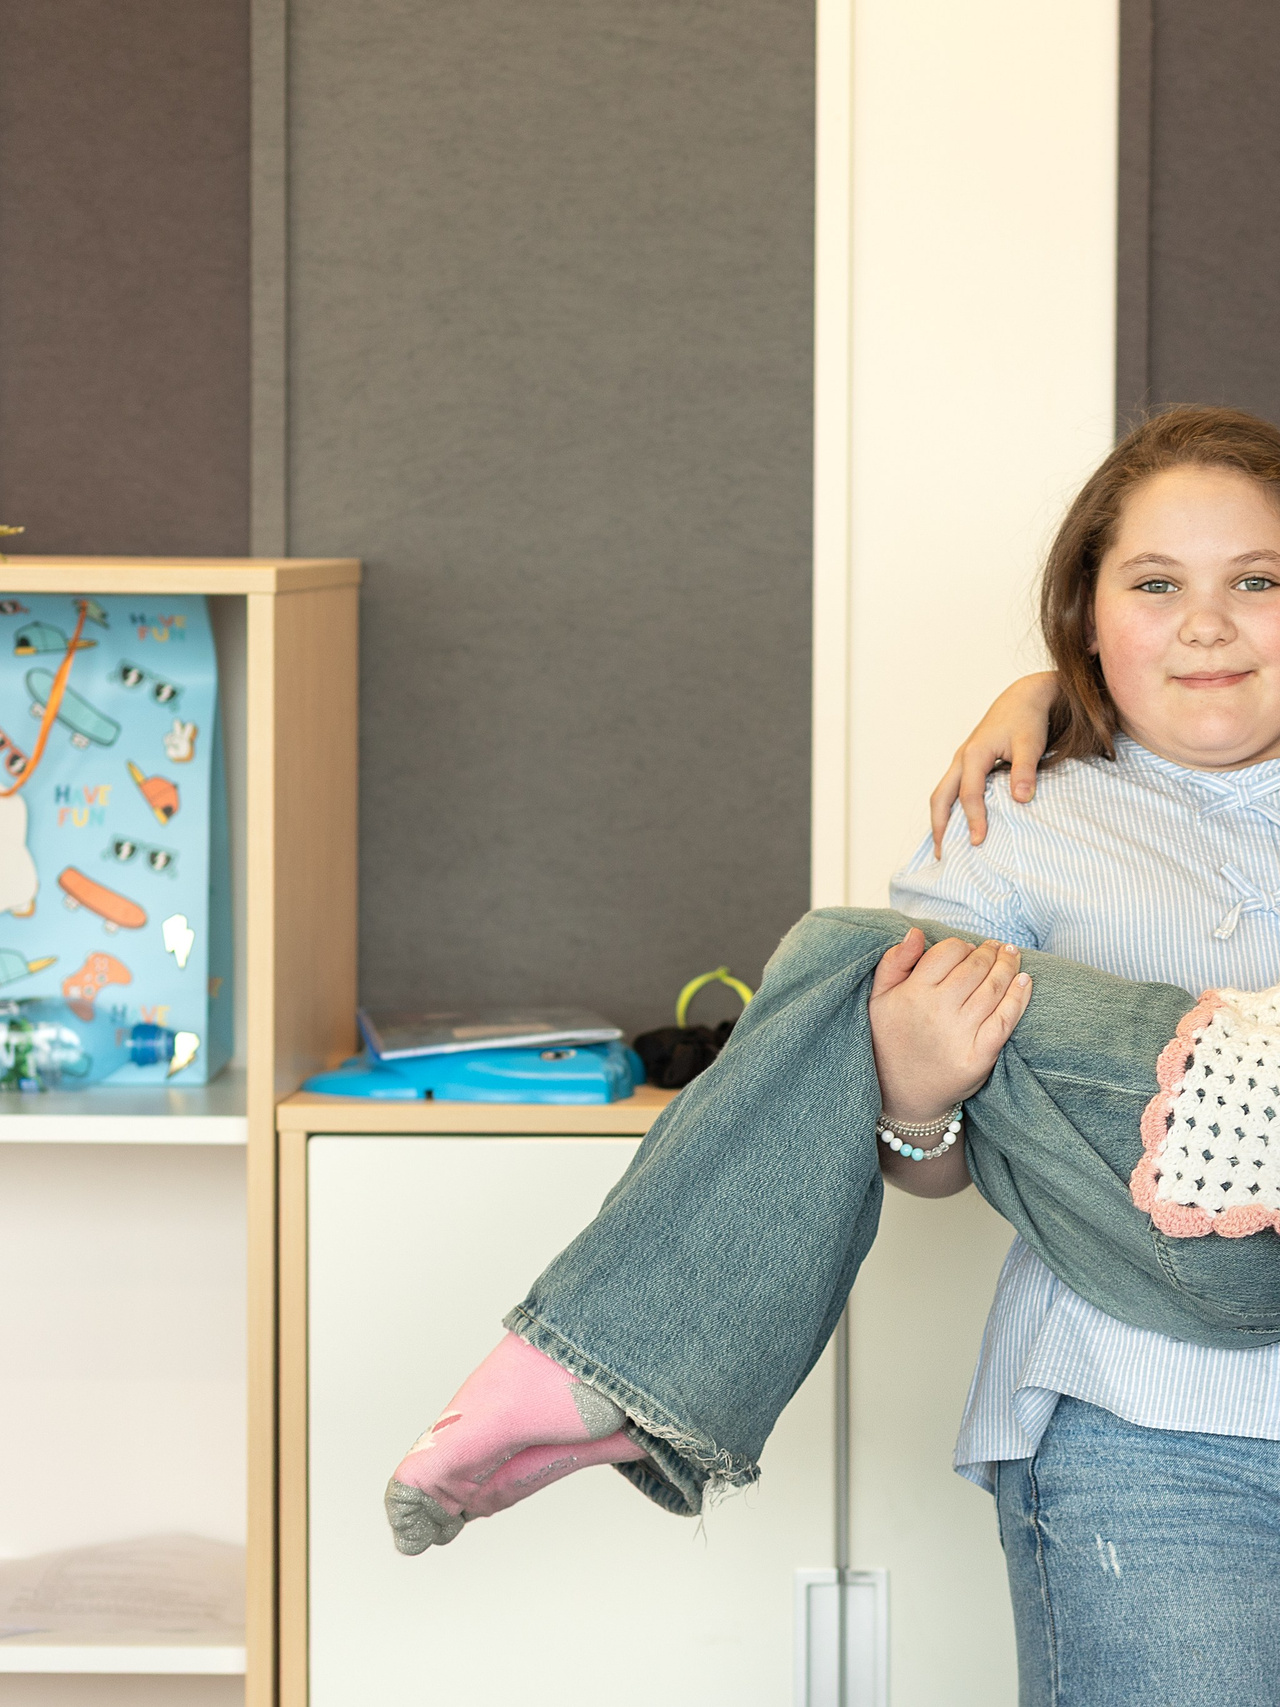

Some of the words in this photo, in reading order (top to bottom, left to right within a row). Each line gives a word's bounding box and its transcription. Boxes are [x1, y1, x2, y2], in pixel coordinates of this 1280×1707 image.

[130, 612, 187, 629] HAVE
[137, 626, 185, 642] FUN
[55, 785, 111, 806] HAVE
[57, 807, 105, 828] FUN
